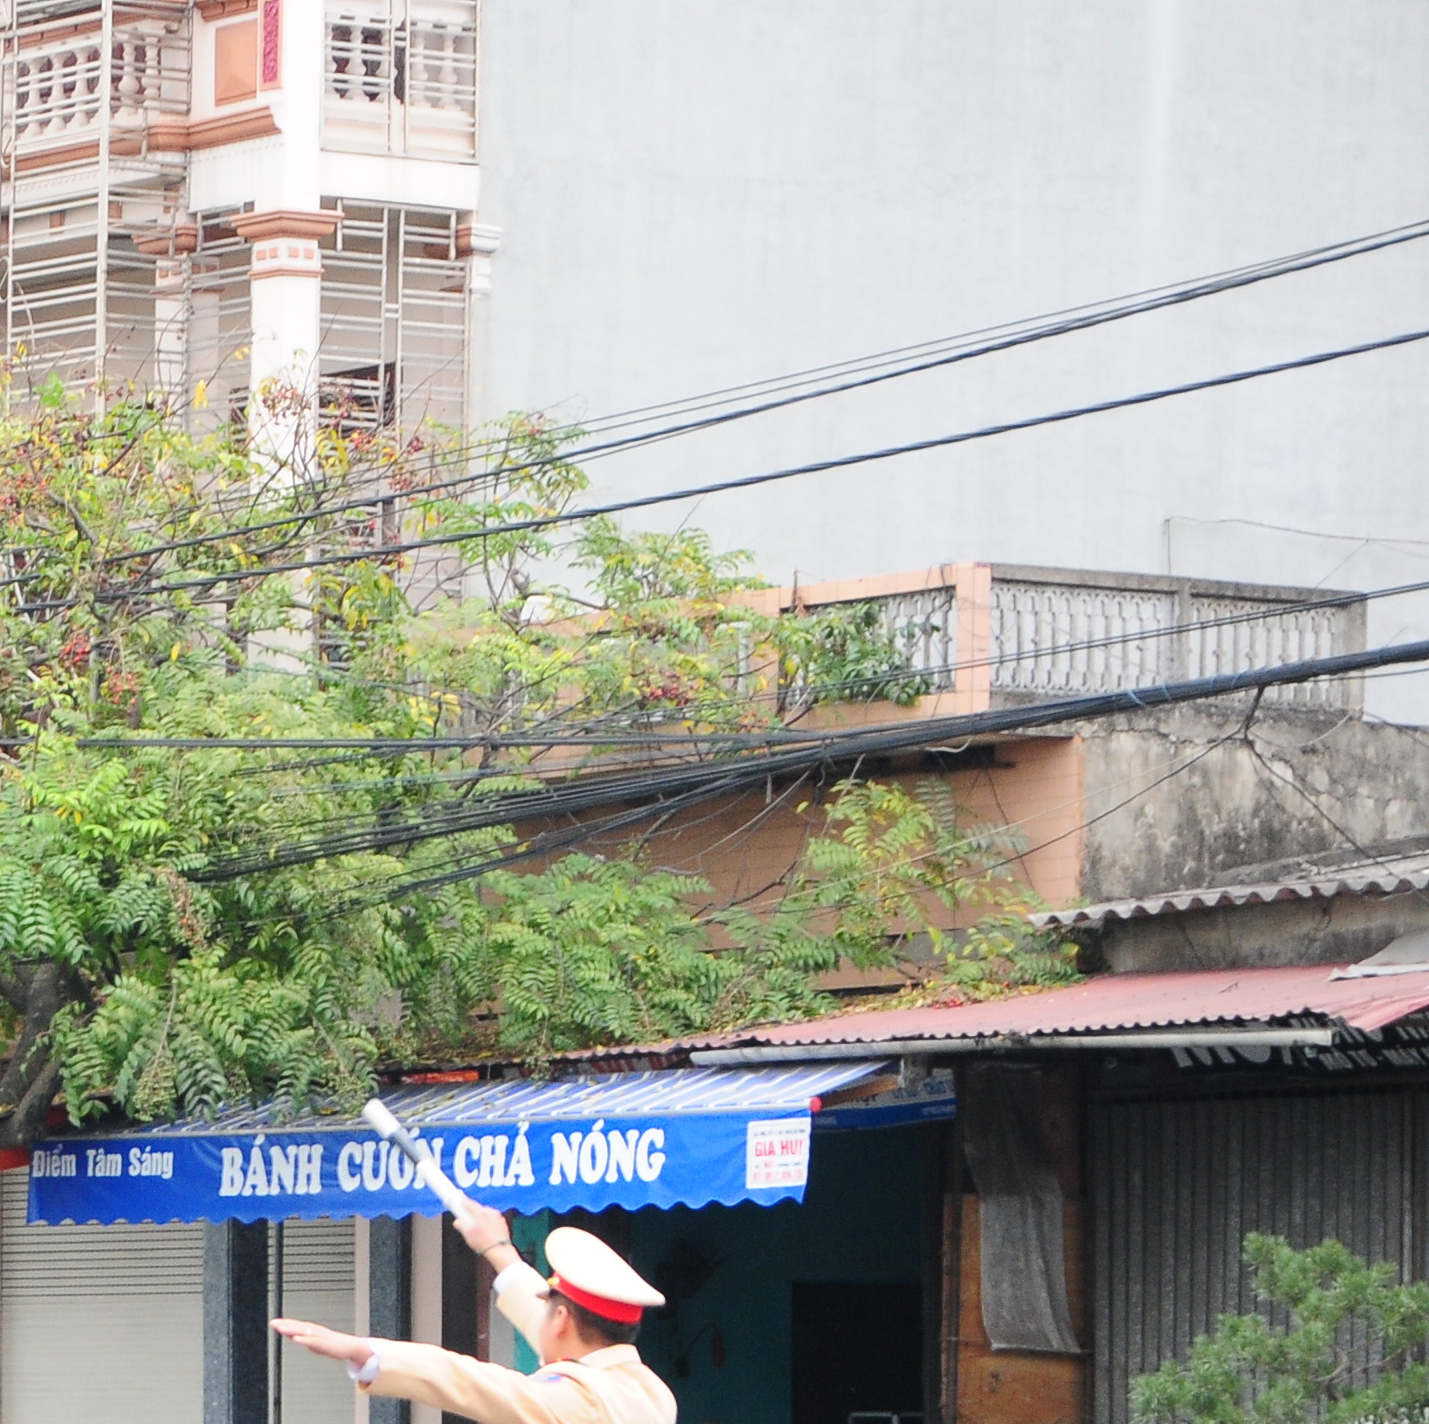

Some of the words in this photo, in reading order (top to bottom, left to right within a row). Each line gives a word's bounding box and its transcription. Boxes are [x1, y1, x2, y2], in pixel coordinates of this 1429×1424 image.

[86, 1143, 123, 1178] Tâm
[128, 1143, 175, 1180] Sáng
[219, 1139, 323, 1198] BÁNH
[452, 1120, 535, 1188] CHẢ
[550, 1118, 667, 1185] NÓNG
[754, 1140, 776, 1157] GIA
